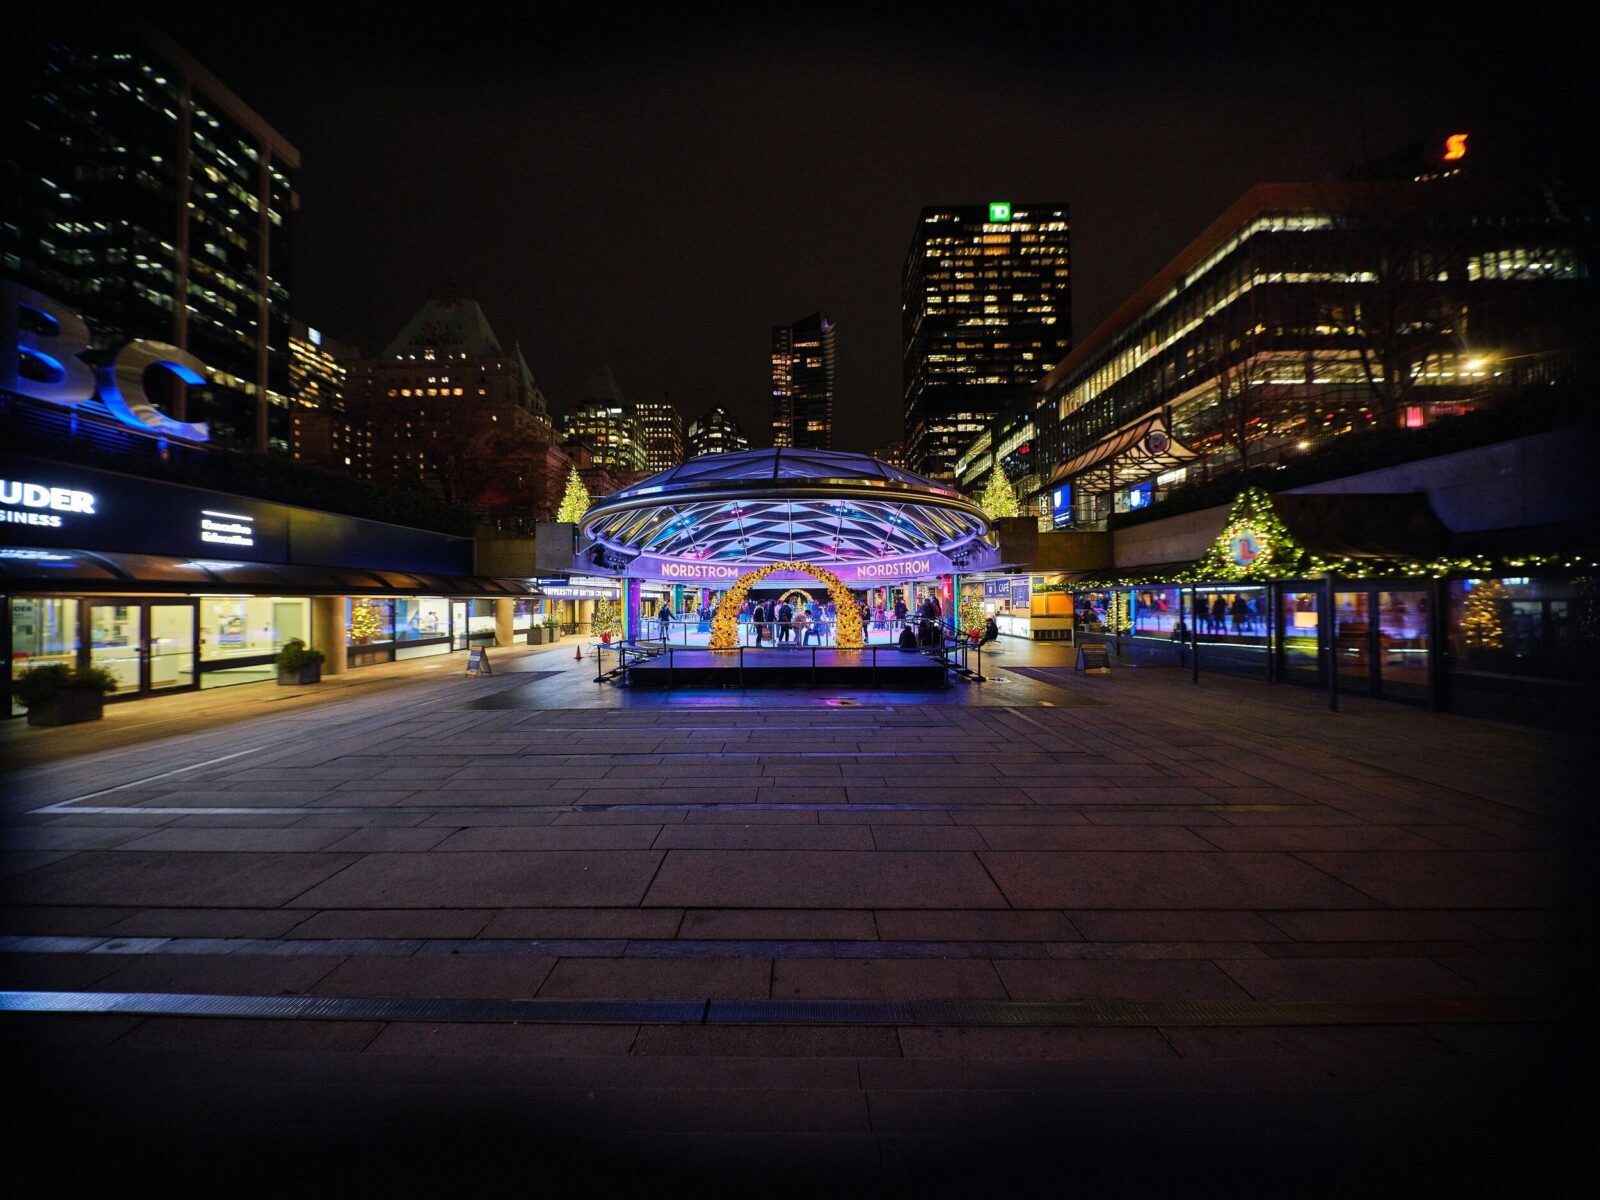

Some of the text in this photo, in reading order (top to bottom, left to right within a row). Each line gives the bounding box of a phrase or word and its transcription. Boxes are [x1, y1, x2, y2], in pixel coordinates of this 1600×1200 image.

[992, 206, 1009, 218] TD
[0, 479, 96, 514] UDER
[661, 563, 738, 578] NORDSTROM
[857, 560, 930, 577] NORDSTROM
